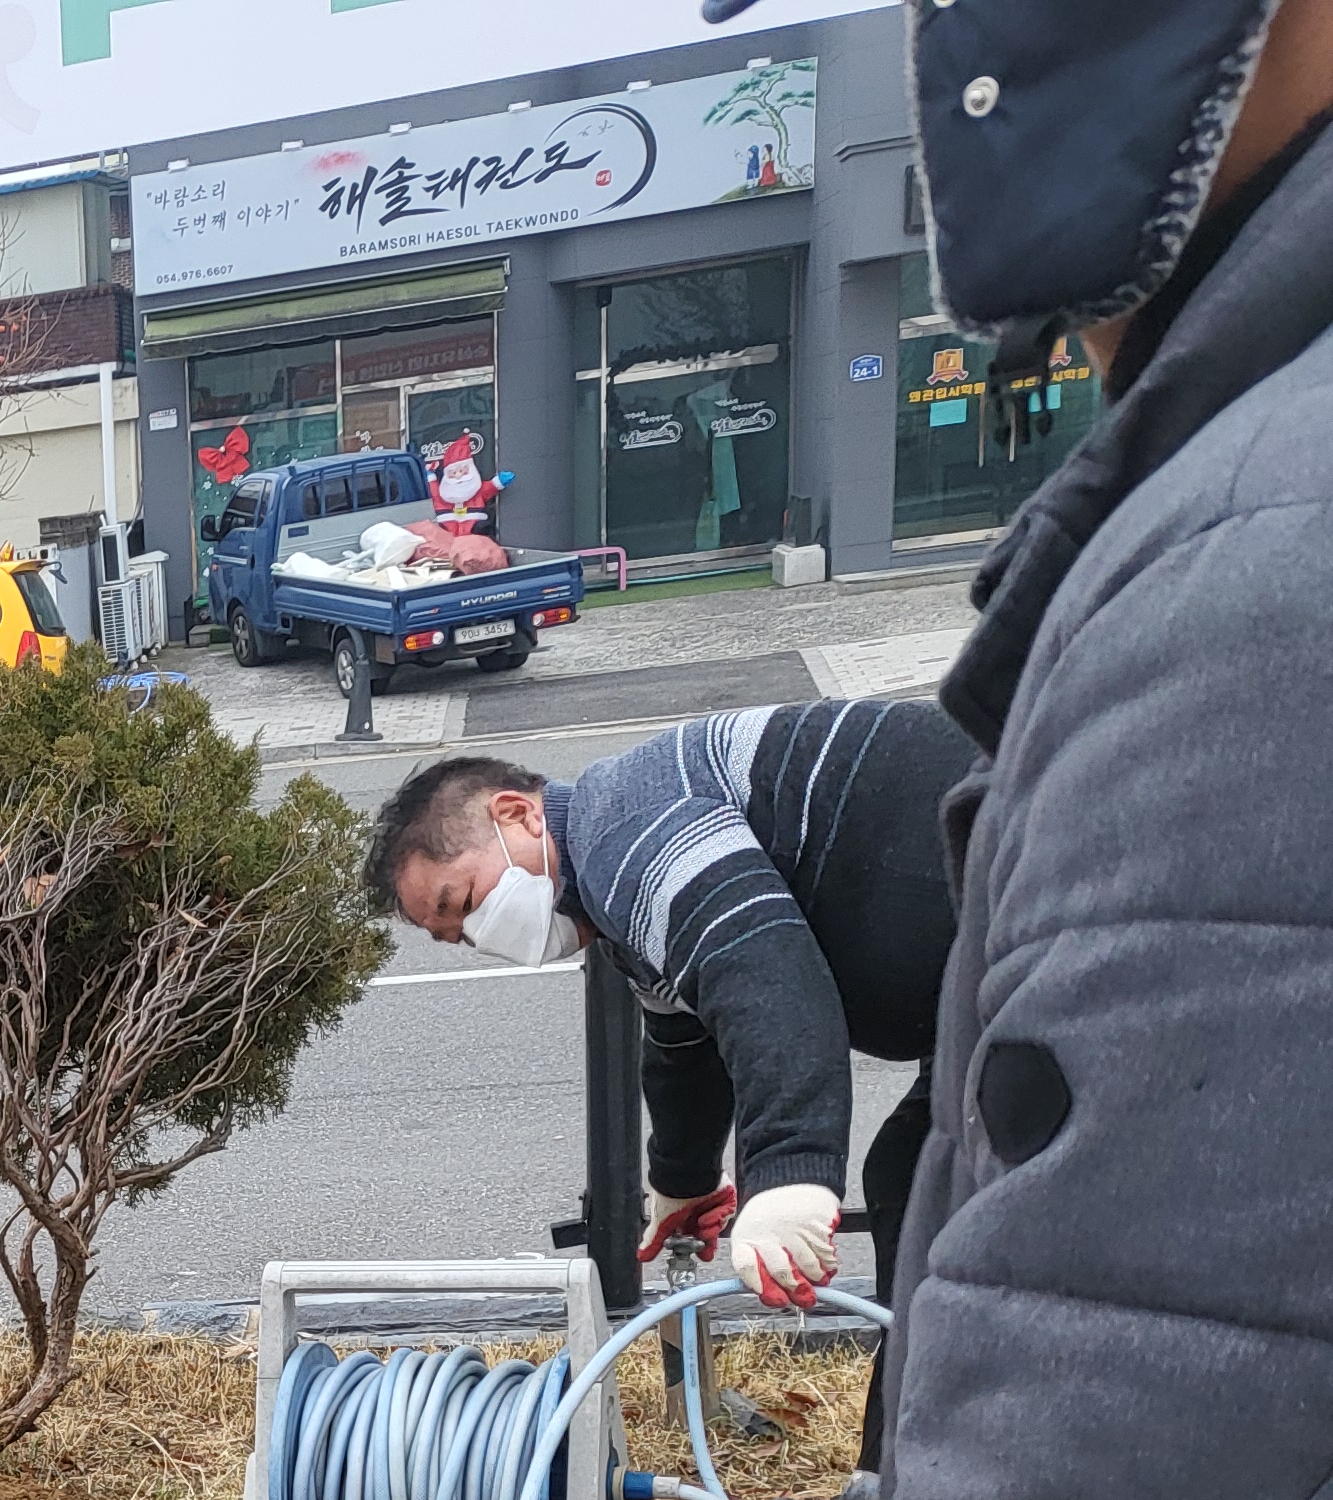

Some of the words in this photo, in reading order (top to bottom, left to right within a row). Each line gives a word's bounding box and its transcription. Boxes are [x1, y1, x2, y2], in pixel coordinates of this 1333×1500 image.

[172, 210, 228, 238] 두번째
[339, 234, 422, 257] BARAMSORI
[426, 225, 482, 244] HAESOL
[486, 208, 580, 235] TAEKWONDO
[852, 365, 879, 378] 24-1
[460, 591, 518, 608] HYUNDAI
